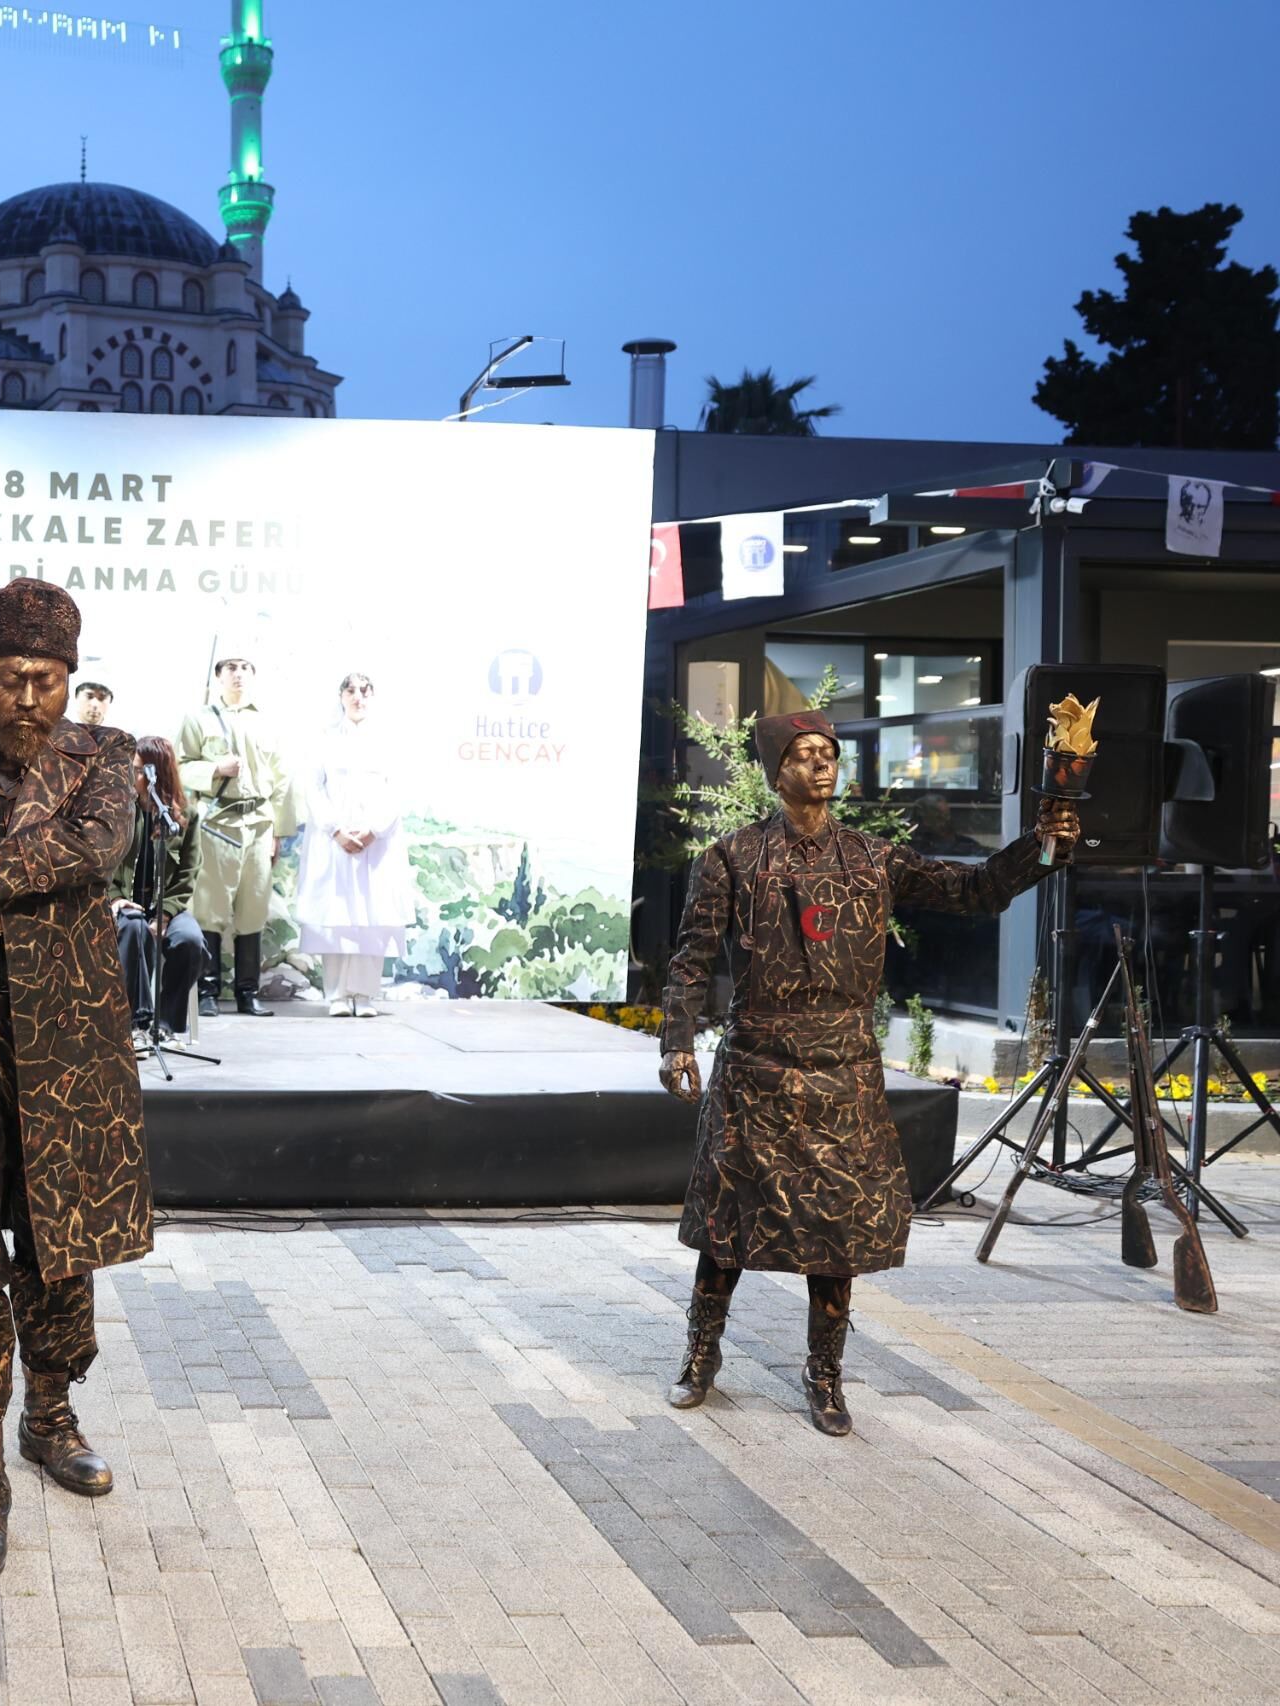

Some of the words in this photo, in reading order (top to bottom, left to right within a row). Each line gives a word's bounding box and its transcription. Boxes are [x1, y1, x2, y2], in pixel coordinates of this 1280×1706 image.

[49, 471, 174, 503] MART
[146, 513, 303, 549] ZAFERİ
[65, 565, 177, 593] ANMA
[197, 562, 305, 595] GÜNÜ
[475, 714, 551, 739] Hatice
[458, 741, 567, 763] GENÇAY
